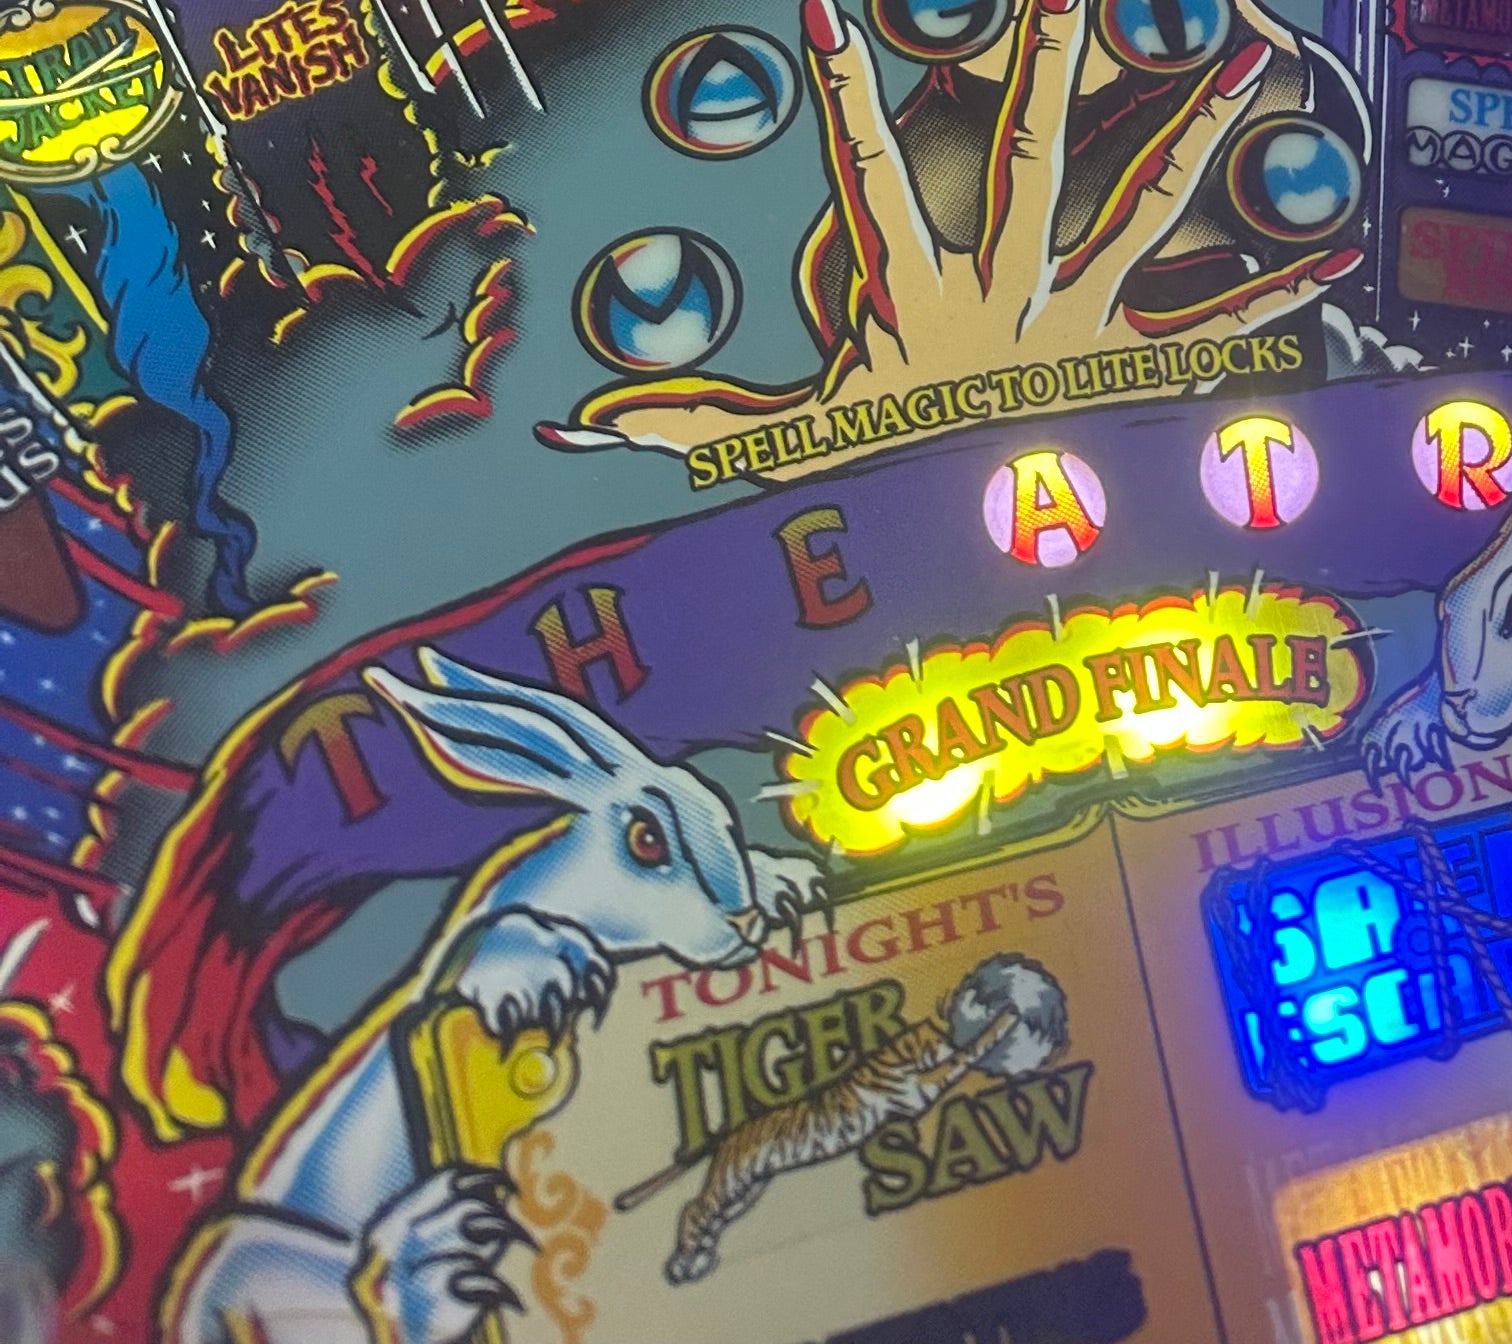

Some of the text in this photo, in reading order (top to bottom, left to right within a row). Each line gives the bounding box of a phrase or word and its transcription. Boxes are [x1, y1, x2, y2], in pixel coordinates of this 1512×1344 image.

[204, 19, 369, 120] VANISH
[676, 32, 778, 140] A
[589, 231, 724, 362] M
[685, 334, 1304, 490] SPELL MAGIC TO LITE LOCKS
[835, 633, 1330, 813] GRAND FINALE
[641, 872, 1066, 1024] TONIGHT'S
[648, 979, 906, 1164] TIGER
[858, 1060, 1096, 1218] SAW
